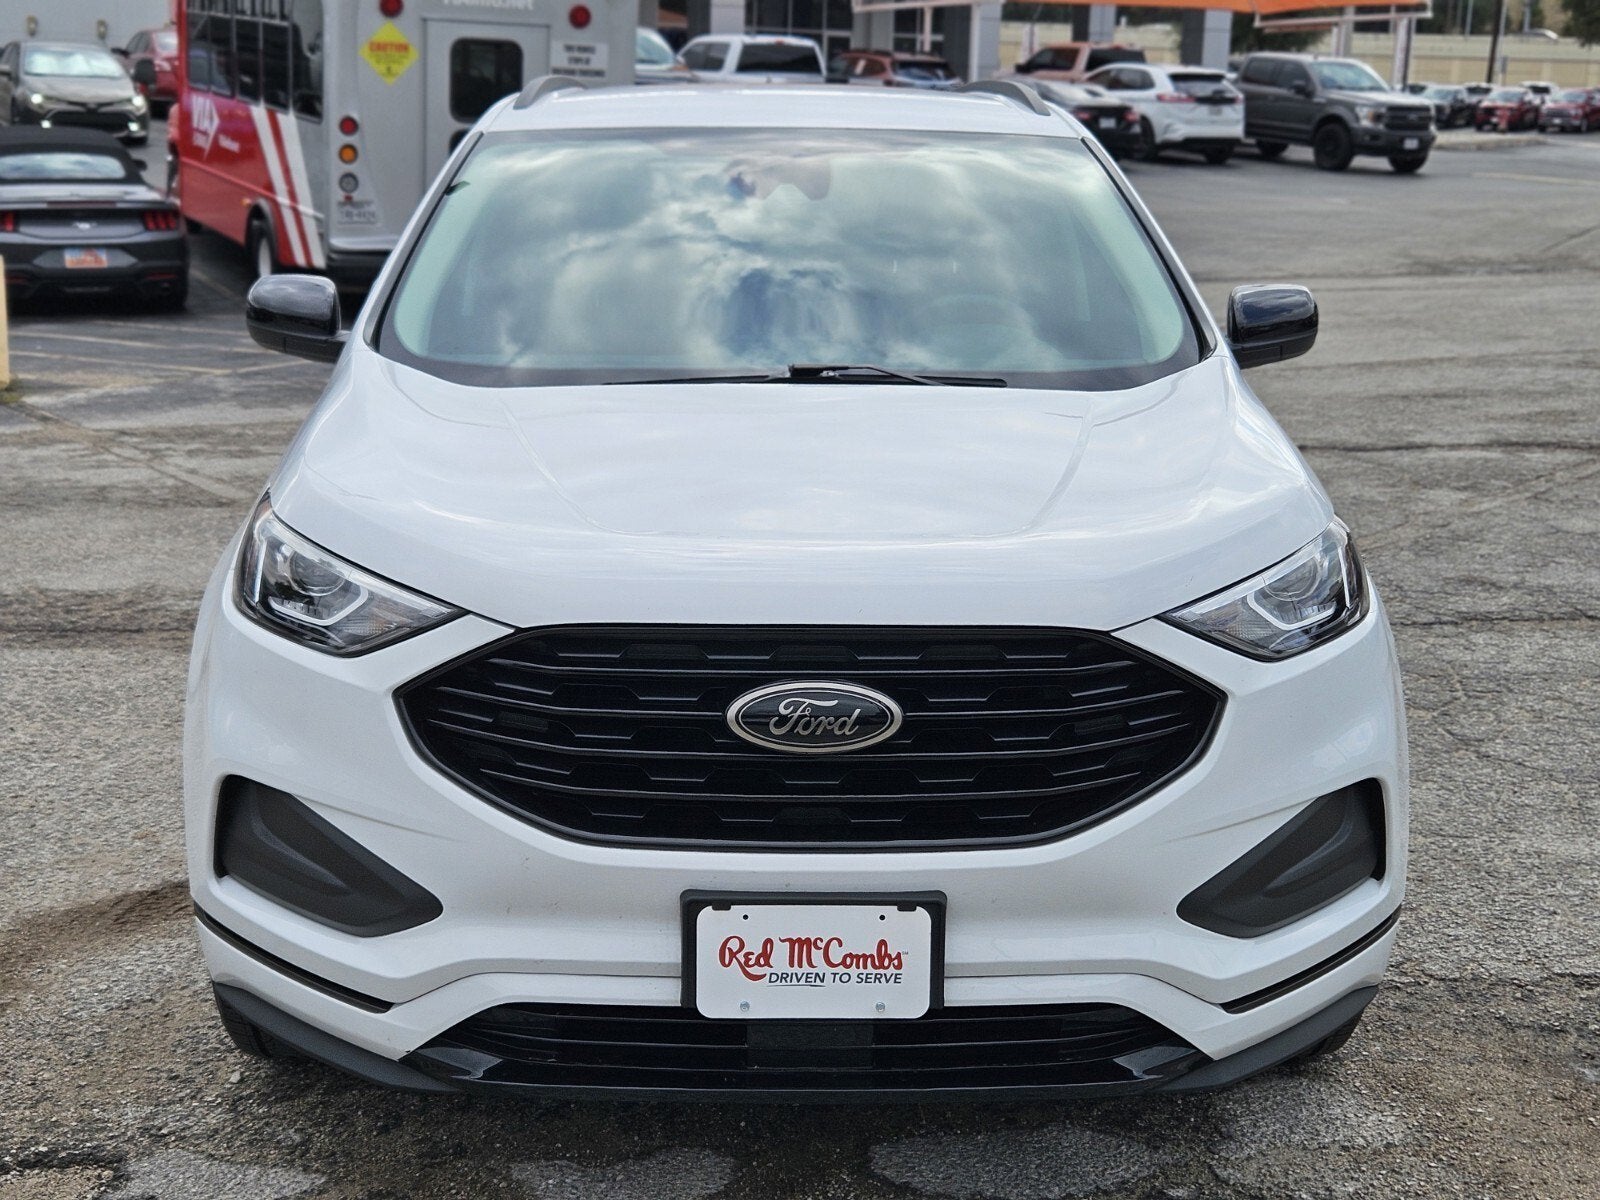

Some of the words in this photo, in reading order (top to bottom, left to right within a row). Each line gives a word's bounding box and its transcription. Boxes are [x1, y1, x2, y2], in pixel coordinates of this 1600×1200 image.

[768, 697, 862, 736] Ford
[718, 935, 774, 982] Red
[778, 936, 903, 971] McCombs
[768, 972, 826, 984] DRIVEN
[830, 972, 851, 984] TO
[855, 972, 903, 985] SERVE
